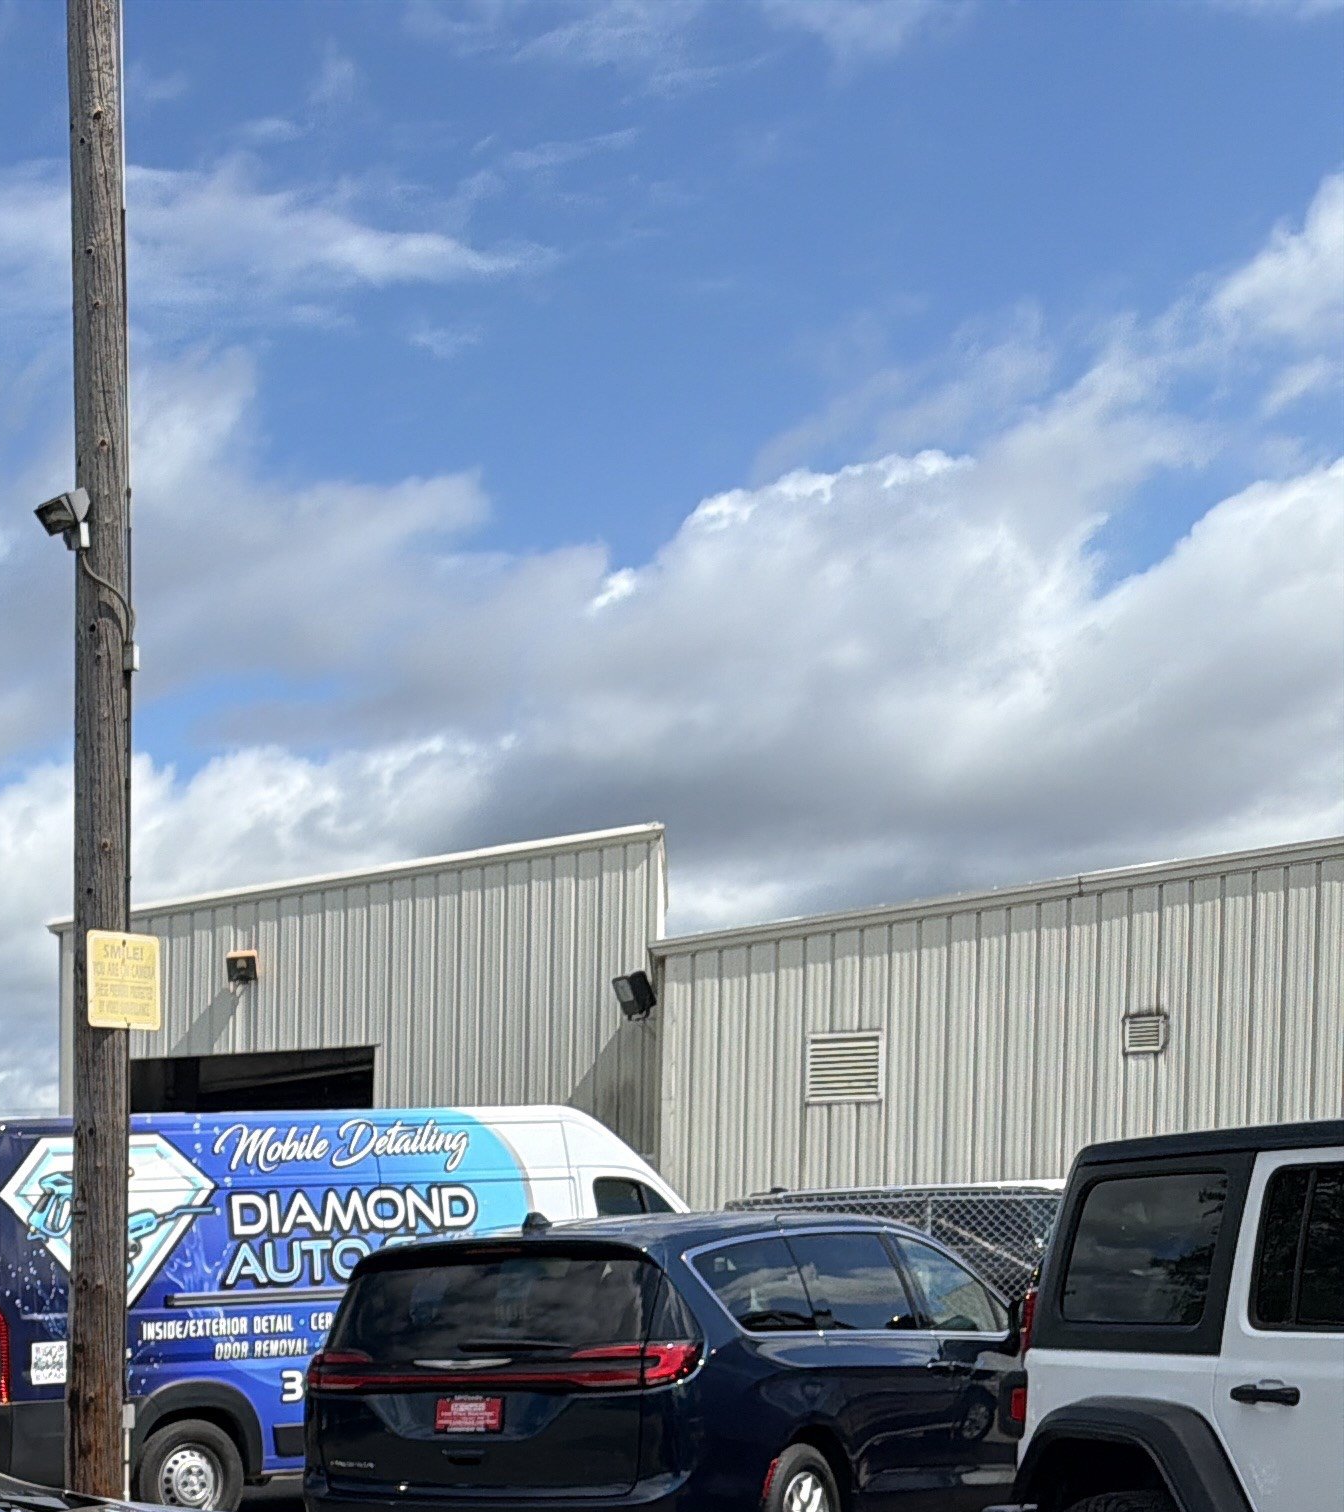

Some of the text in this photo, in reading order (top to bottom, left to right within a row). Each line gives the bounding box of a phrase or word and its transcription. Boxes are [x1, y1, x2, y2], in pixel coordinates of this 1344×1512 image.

[213, 1118, 469, 1173] Mobile Detailing
[231, 1188, 476, 1236] DIAMOND
[142, 1315, 248, 1341] INSIDE/EXTERIOR
[253, 1314, 294, 1333] DETAIL
[215, 1338, 308, 1360] ODOR REMOVAL
[281, 1370, 304, 1402] 3
